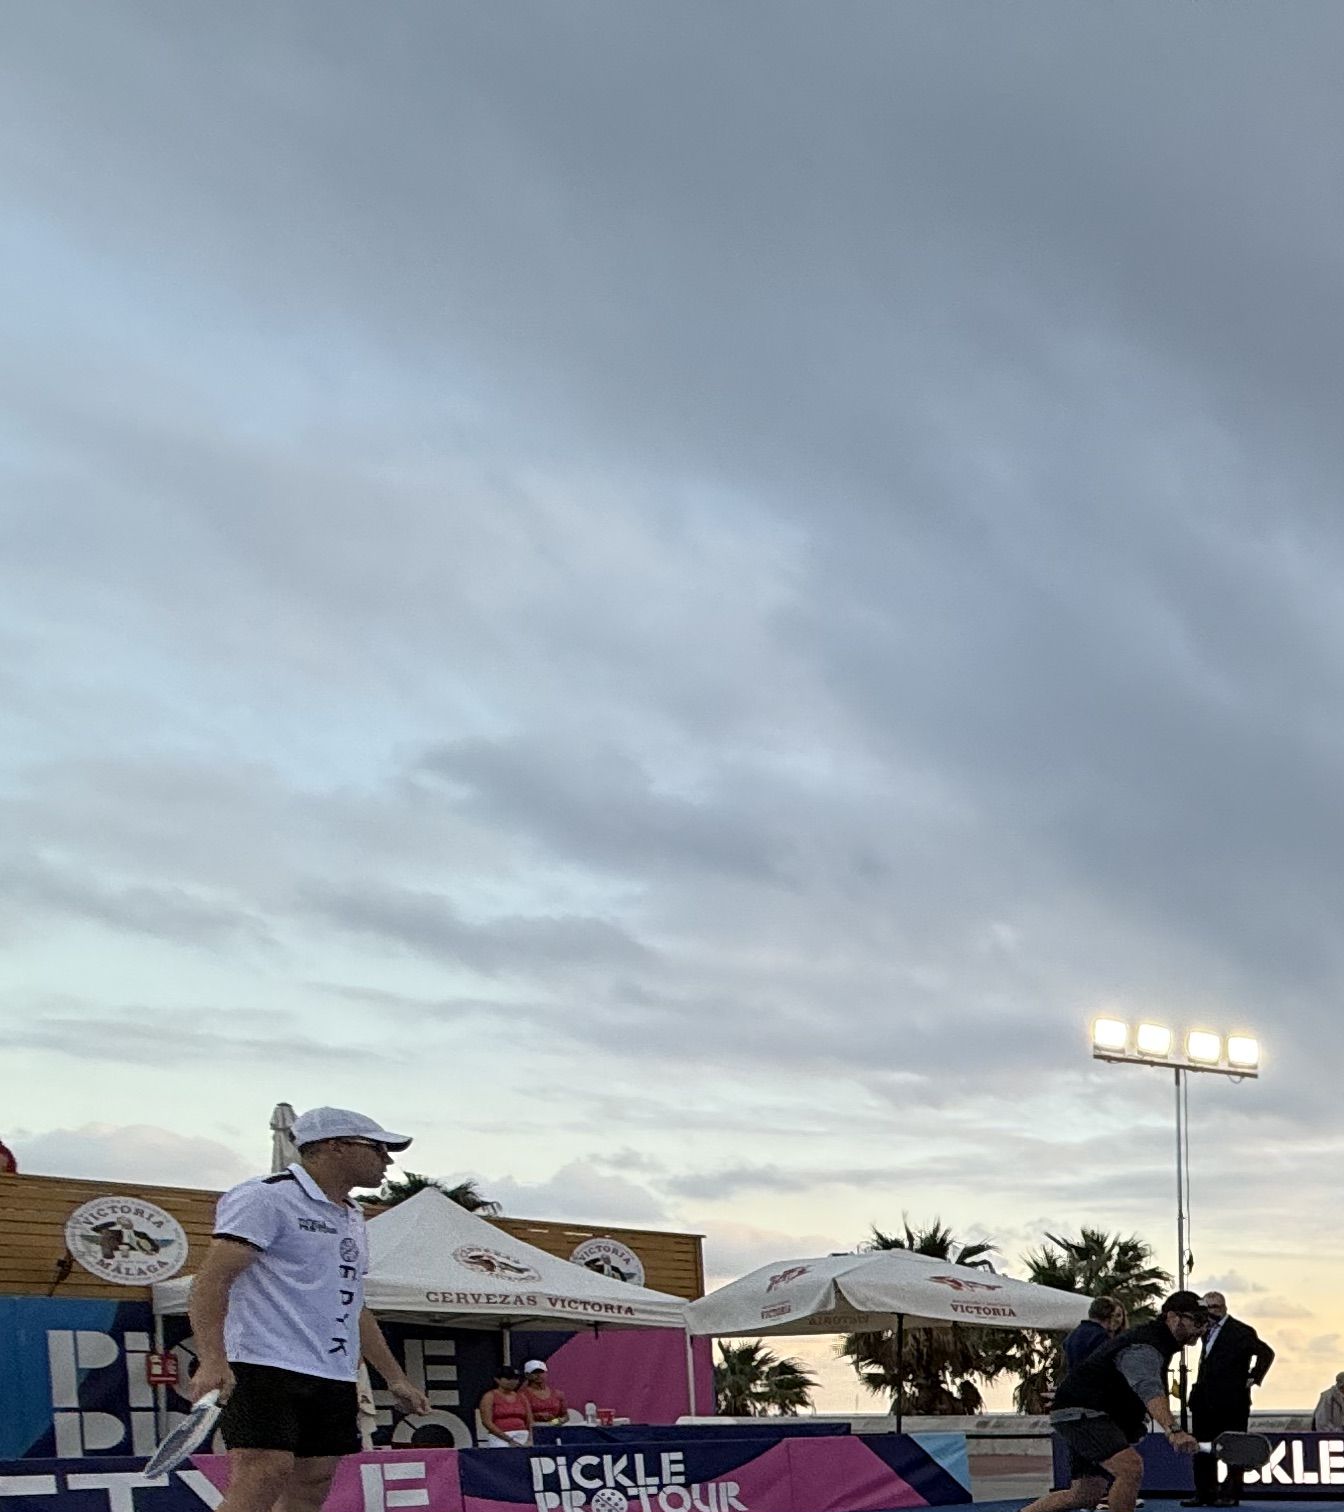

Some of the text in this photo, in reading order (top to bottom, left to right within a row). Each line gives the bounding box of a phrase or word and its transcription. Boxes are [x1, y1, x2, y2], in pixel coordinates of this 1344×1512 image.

[82, 1205, 165, 1229] VICTORIA
[579, 1245, 631, 1265] VICTORIA
[425, 1291, 636, 1316] CERVEZAS VICTORIA
[950, 1302, 1017, 1318] VICTORIA
